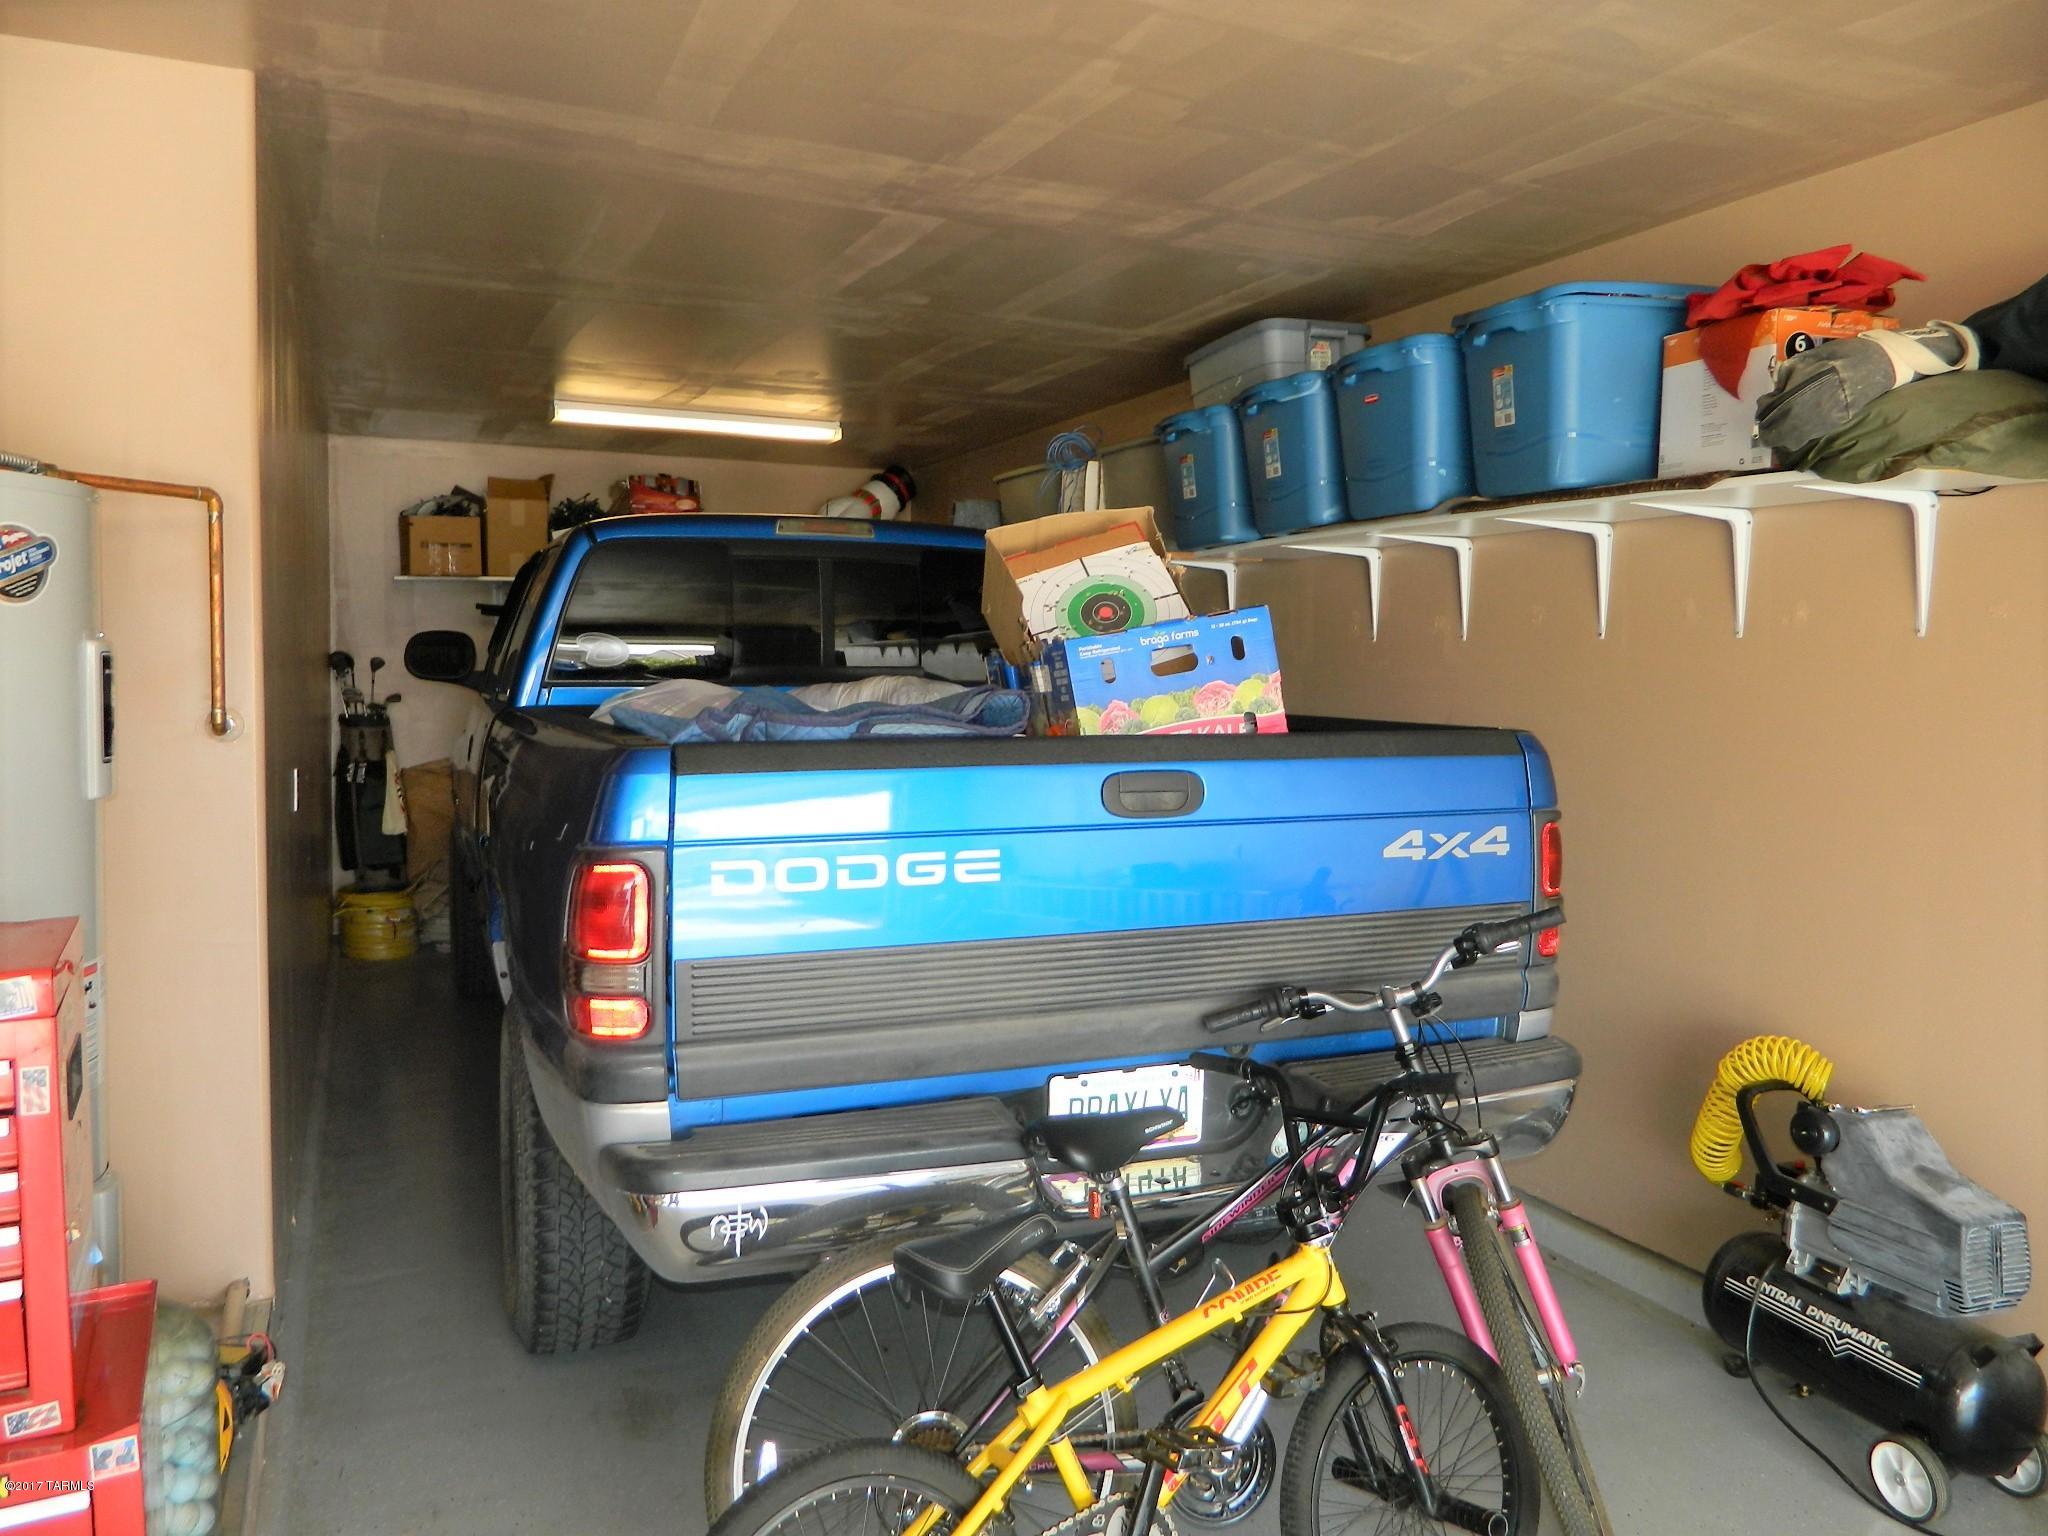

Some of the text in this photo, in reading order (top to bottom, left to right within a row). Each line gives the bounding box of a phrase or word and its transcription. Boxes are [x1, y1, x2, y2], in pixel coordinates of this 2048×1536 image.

[1795, 335, 1807, 352] 6
[0, 550, 28, 574] ojet
[709, 848, 1001, 897] DODGE
[1805, 1304, 1890, 1354] PNEUMATIC
